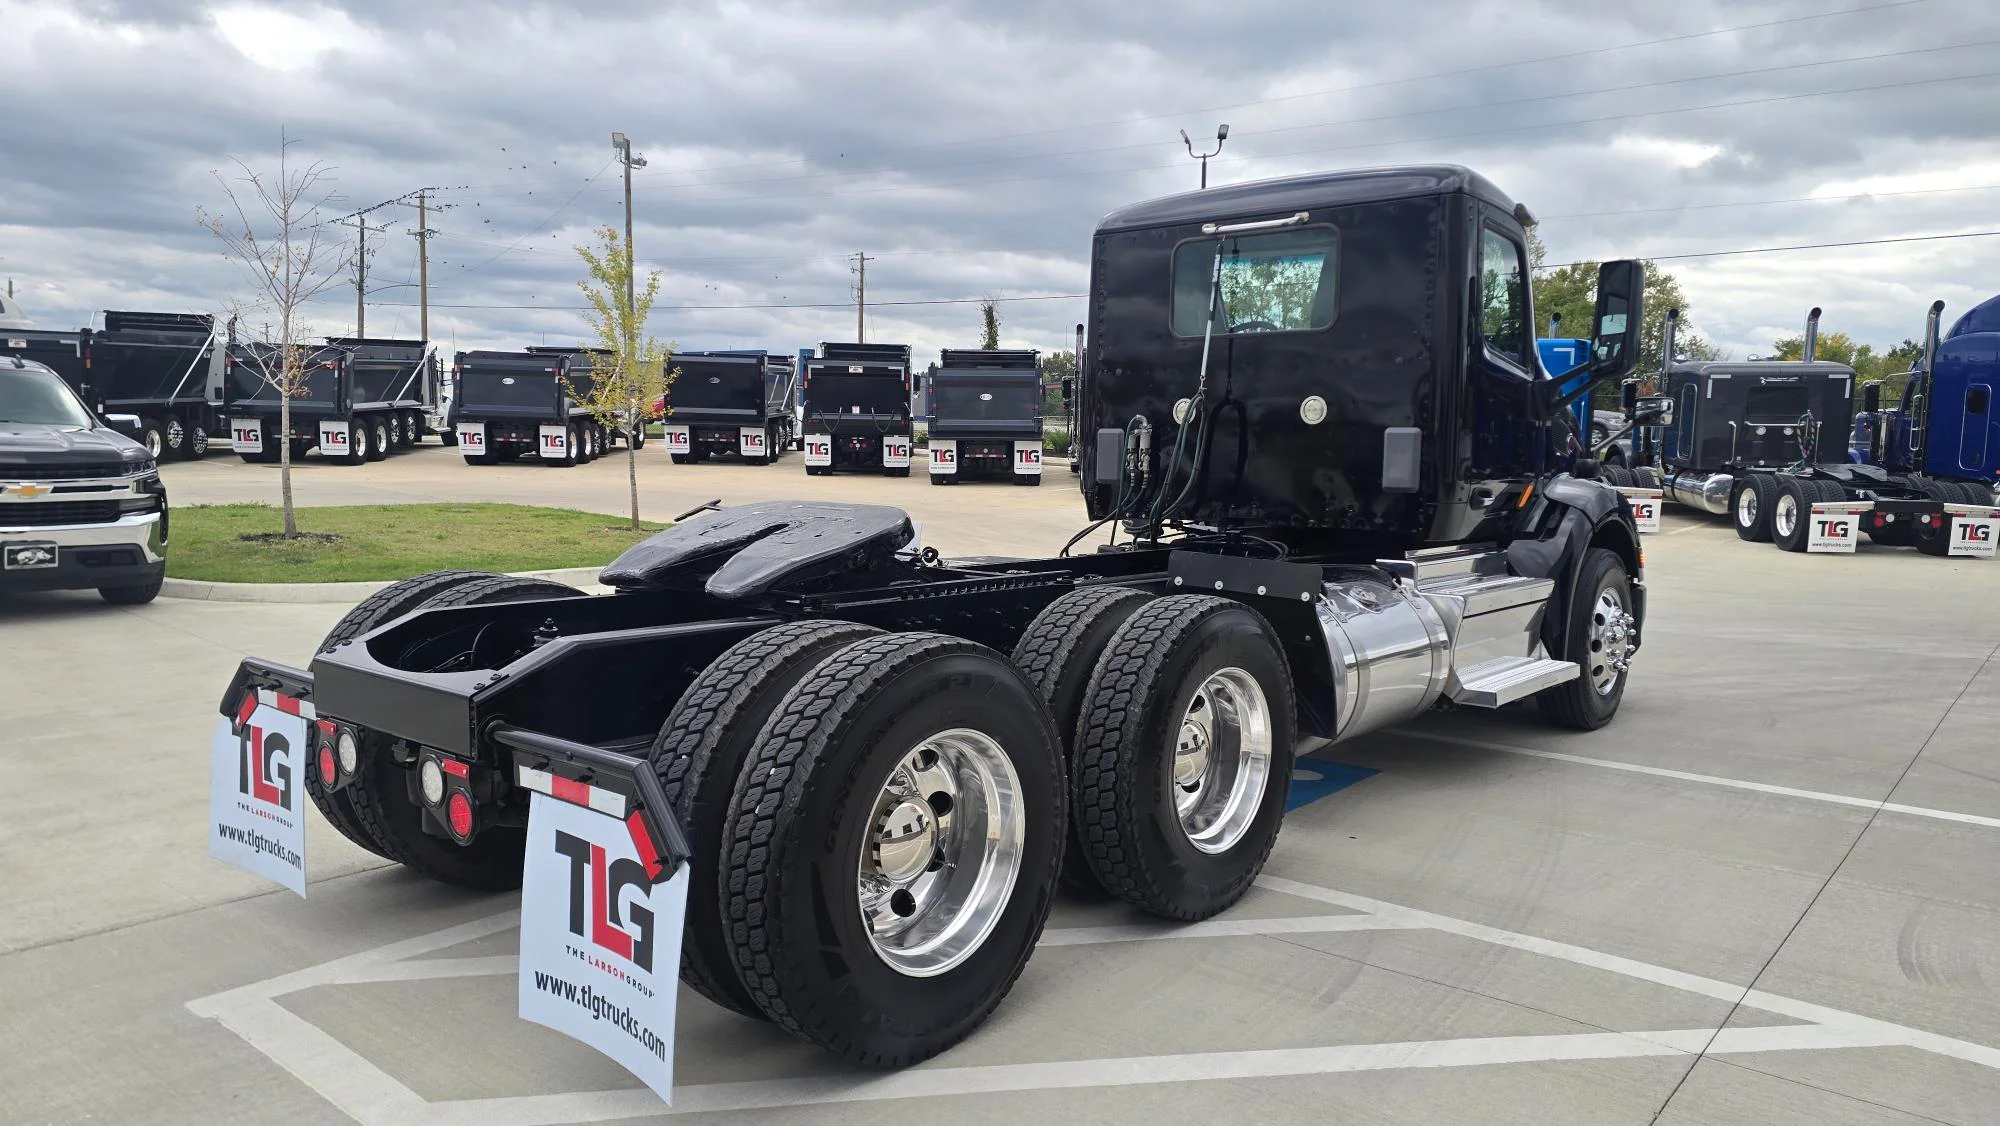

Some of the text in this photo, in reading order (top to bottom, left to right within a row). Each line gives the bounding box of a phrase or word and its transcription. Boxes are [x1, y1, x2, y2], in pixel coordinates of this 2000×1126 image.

[234, 429, 259, 441] TLG
[322, 431, 346, 444] TLG
[460, 432, 482, 445] TLG
[542, 432, 564, 447] TLG
[667, 432, 687, 444] TLG
[742, 435, 762, 446] TLG
[806, 442, 829, 456] TLG
[885, 444, 908, 457] TLG
[931, 449, 954, 463] TLG
[1016, 449, 1040, 463] TLG
[1817, 520, 1849, 537] TLG
[1958, 523, 1990, 541] TLG
[231, 723, 292, 812] TLG
[237, 802, 294, 829] THE LARSON GROUP
[218, 822, 302, 871] www.tlgtrucks.com
[555, 828, 655, 975] TLG
[565, 944, 654, 999] THE LARSON GROUP
[534, 970, 666, 1062] www.tlgtrucks.com
